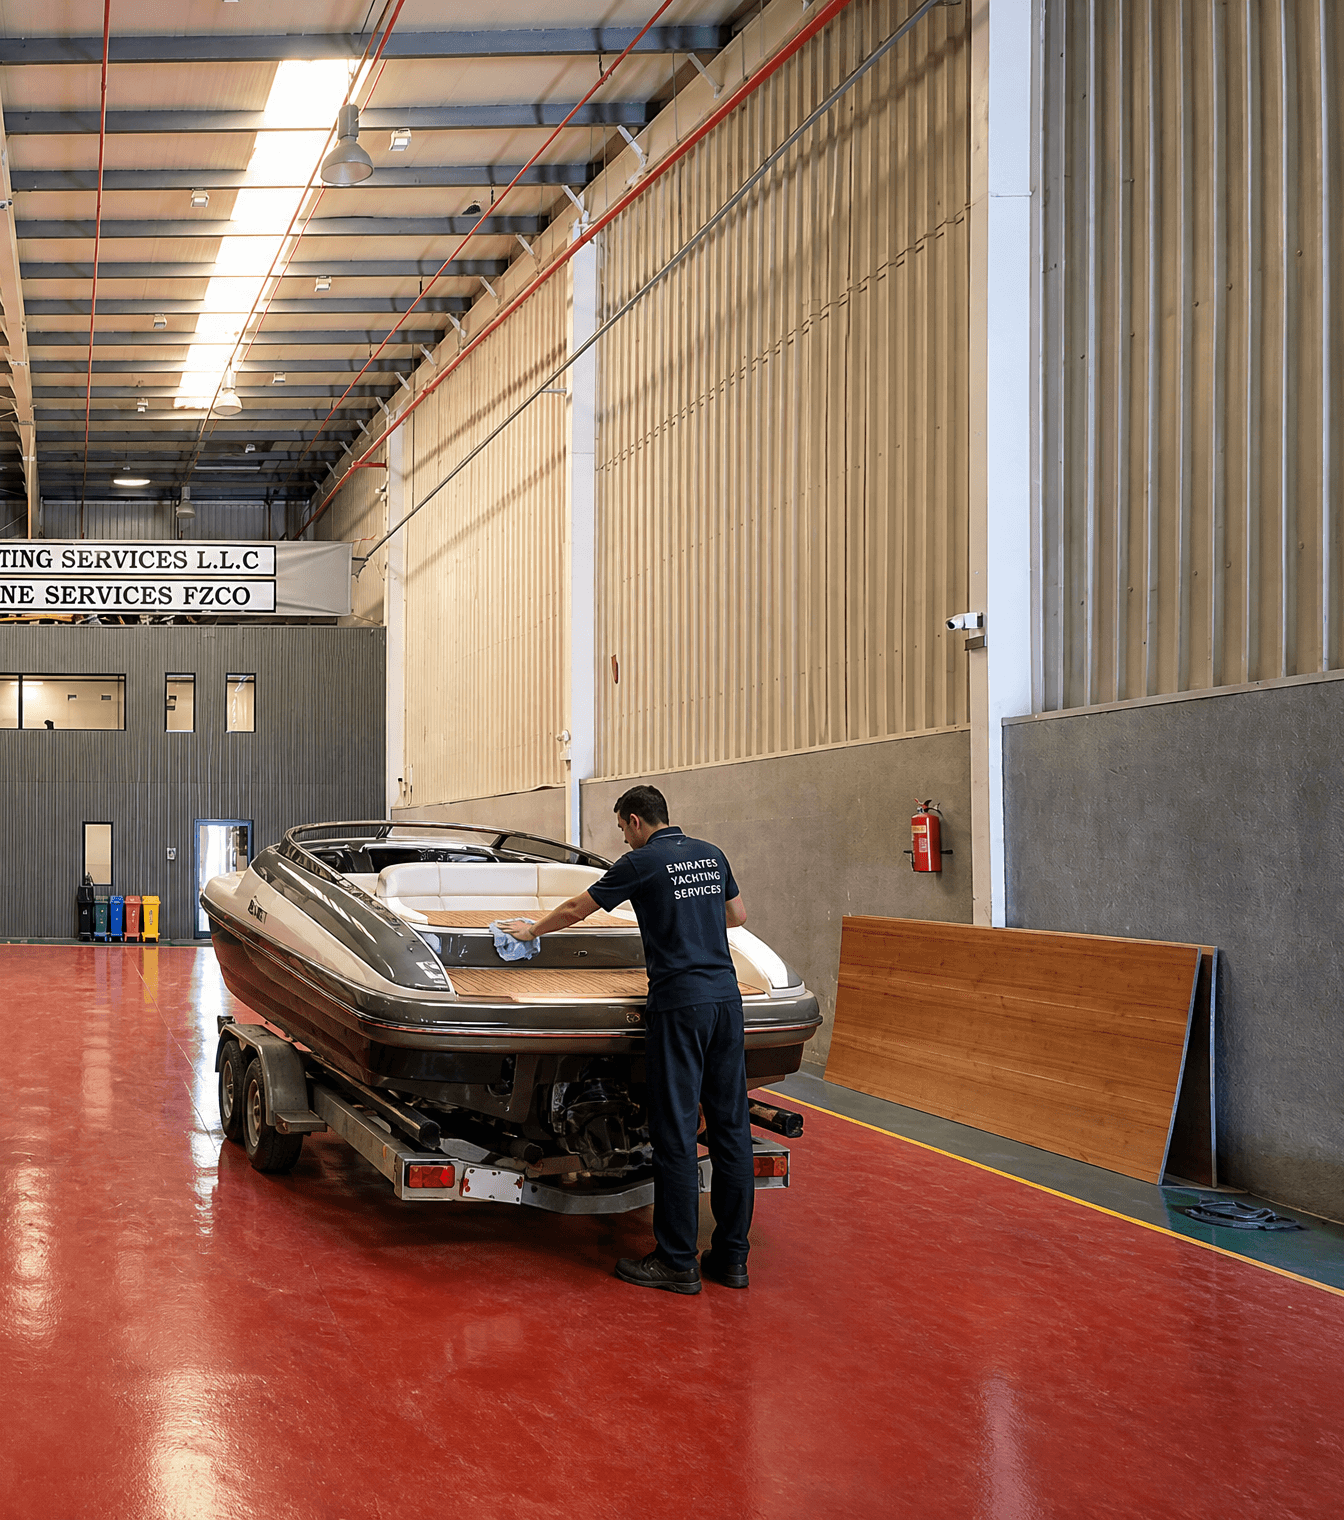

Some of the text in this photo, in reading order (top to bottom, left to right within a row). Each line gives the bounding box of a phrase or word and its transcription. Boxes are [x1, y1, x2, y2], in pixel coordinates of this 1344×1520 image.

[61, 549, 188, 569] SERVICES
[196, 550, 259, 570] L.L.C
[45, 585, 173, 605] SERVICES
[183, 586, 251, 606] FZCO
[666, 858, 718, 873] EMIRATES
[670, 871, 721, 885] YACHTING
[674, 884, 721, 900] SERVICES
